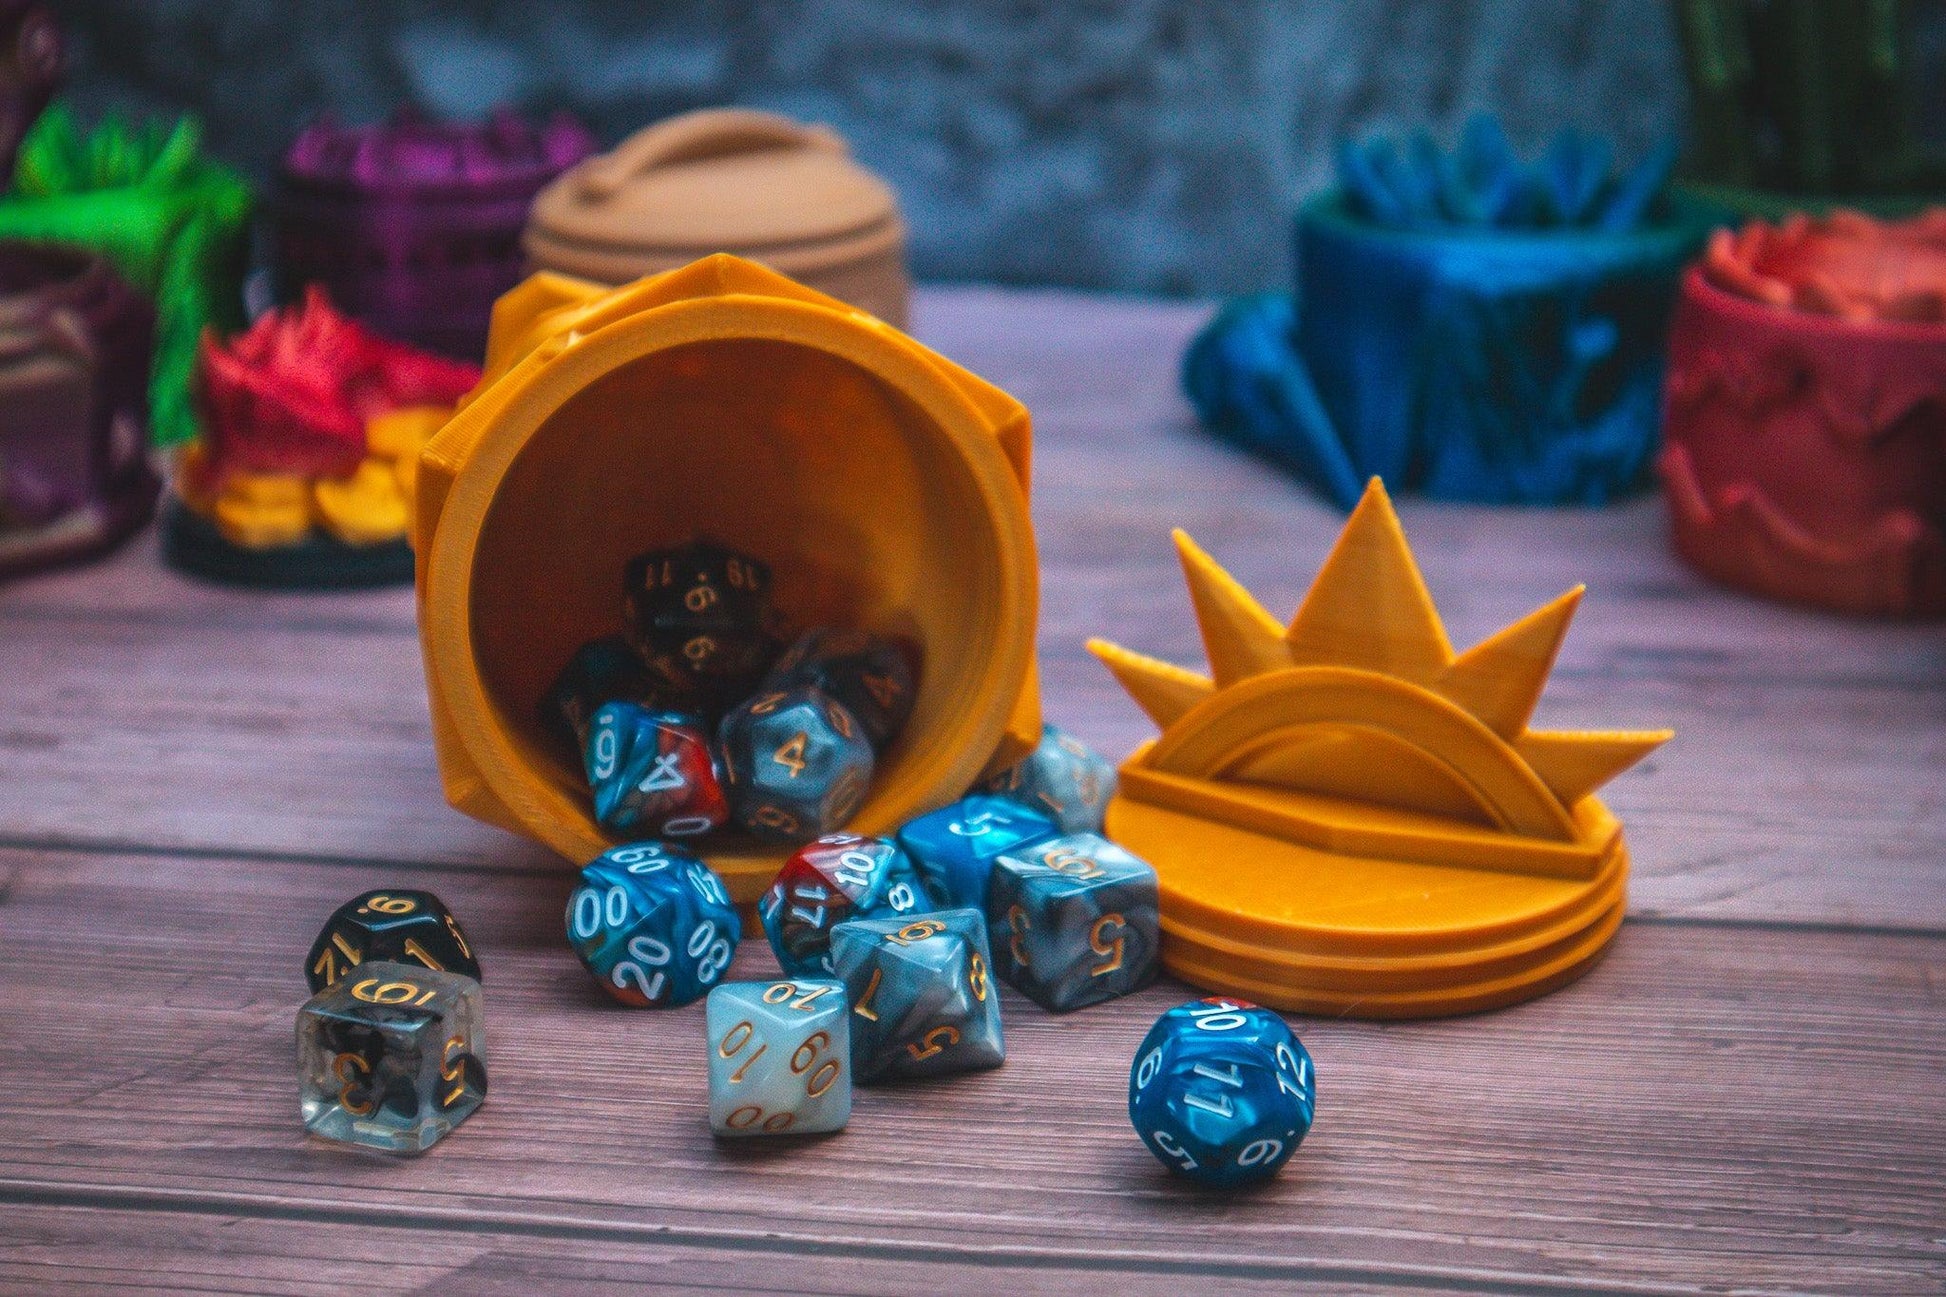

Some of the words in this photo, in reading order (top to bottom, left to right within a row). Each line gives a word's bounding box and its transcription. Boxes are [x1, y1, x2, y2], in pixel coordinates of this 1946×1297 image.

[638, 752, 687, 793] 4
[773, 731, 808, 778] 4
[834, 851, 875, 886] 10
[574, 885, 628, 938] 00
[792, 885, 827, 929] 17
[888, 882, 915, 912] 8
[612, 936, 671, 999] 20
[687, 919, 730, 984] 80
[1090, 912, 1125, 977] 5
[970, 952, 987, 1002] 8
[1189, 1002, 1247, 1031] 10
[719, 1020, 767, 1083] 10
[906, 1025, 960, 1061] 5
[334, 1052, 371, 1117] 3
[1183, 1062, 1244, 1119] 11
[1276, 1041, 1307, 1101] 12
[1153, 1130, 1199, 1171] 5
